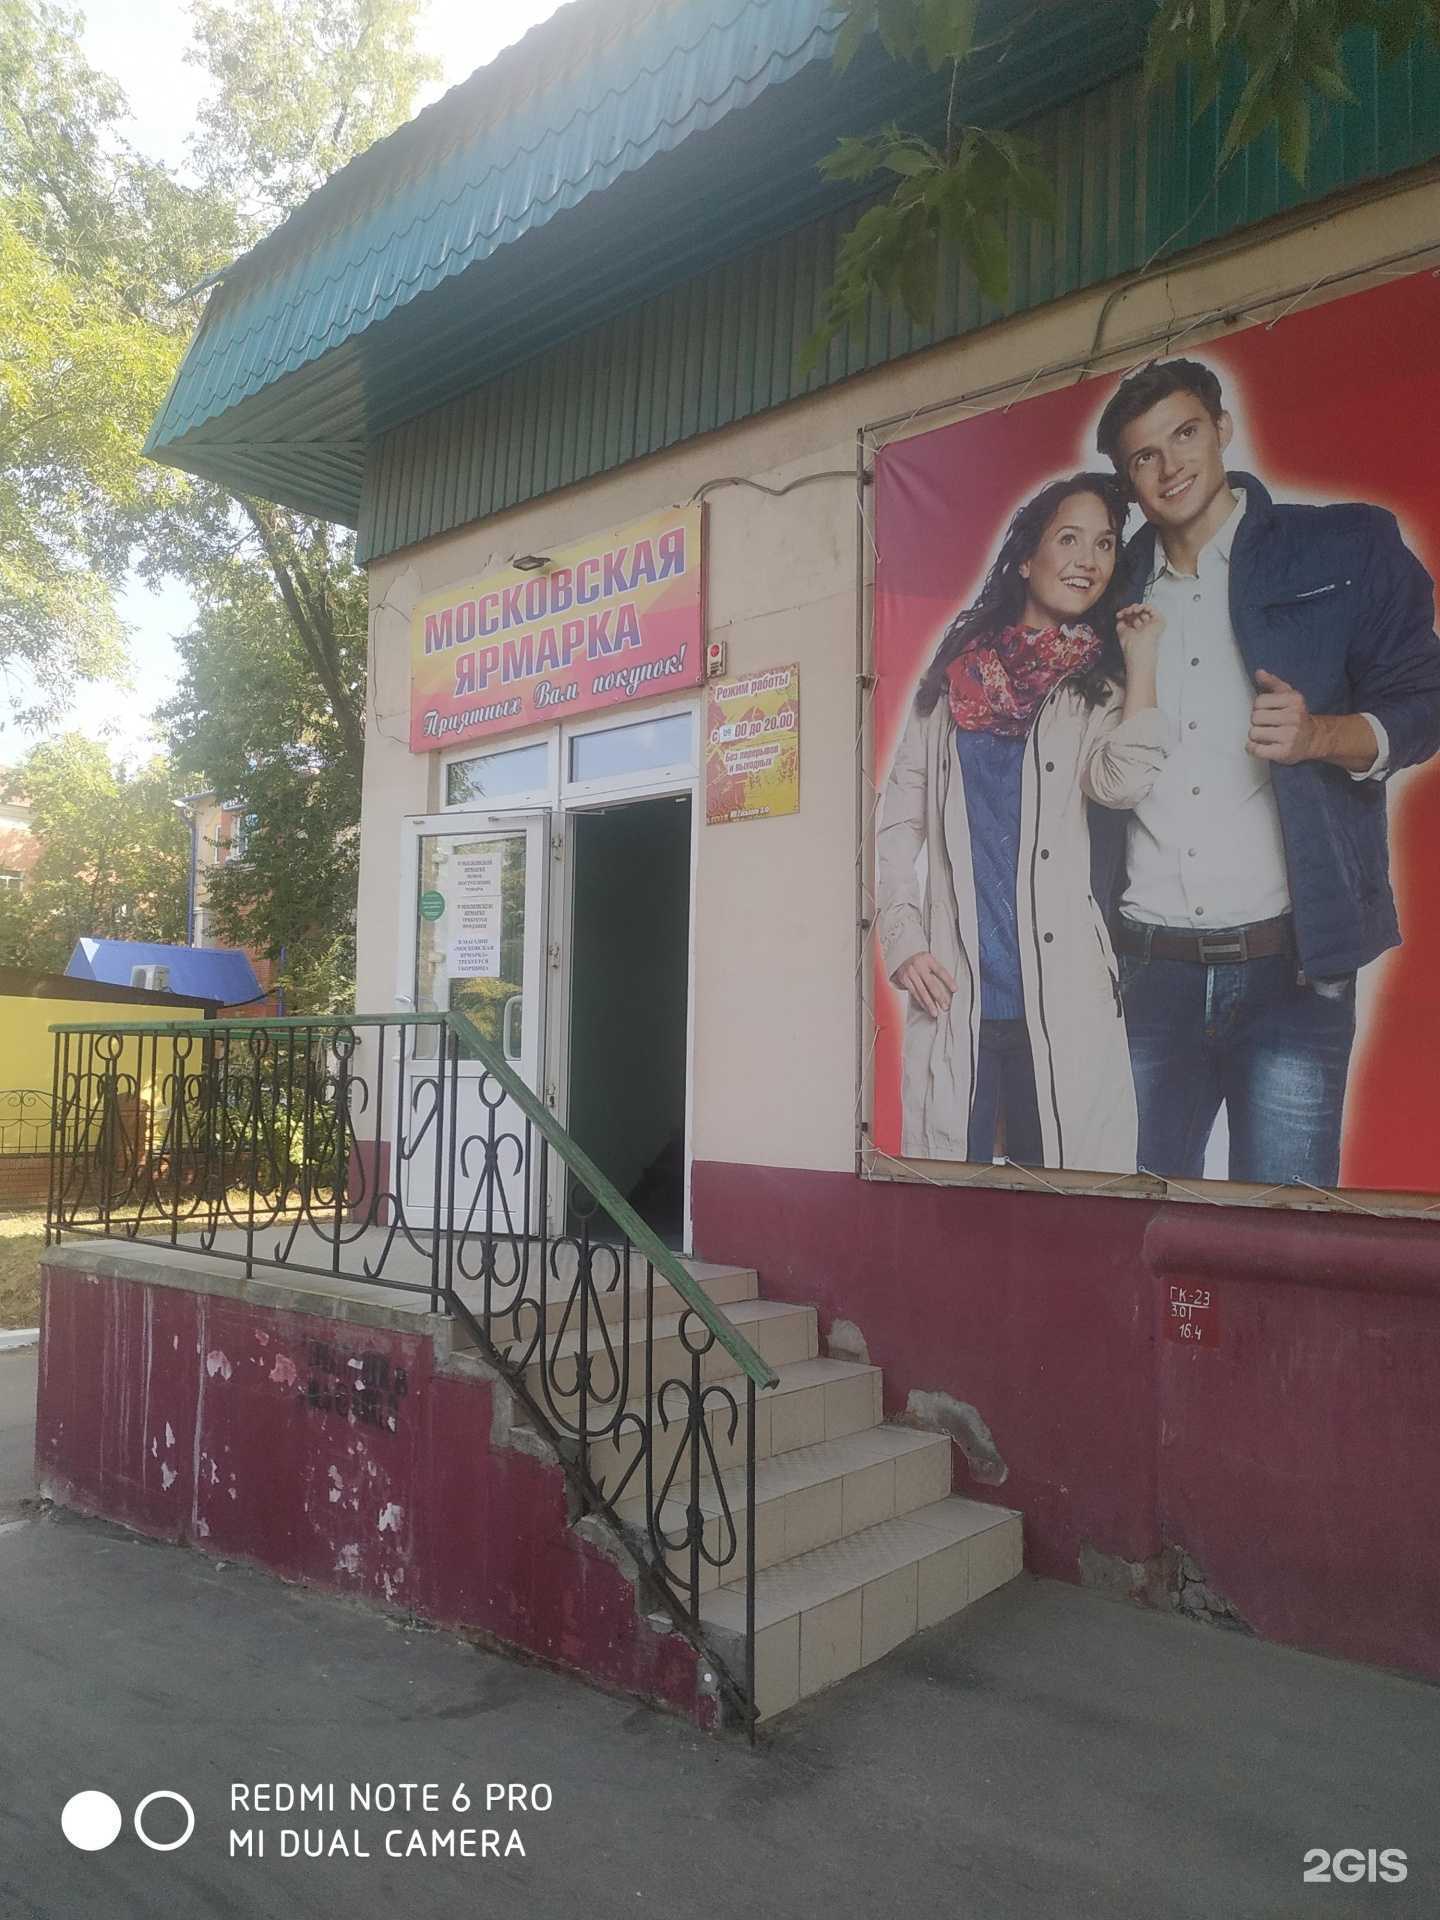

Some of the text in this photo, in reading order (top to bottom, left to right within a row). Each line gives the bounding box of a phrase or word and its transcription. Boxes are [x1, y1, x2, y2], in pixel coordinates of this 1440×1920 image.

[424, 527, 686, 656] МОСКОВСКАЯ
[423, 643, 688, 737] Приятных Вам покупок!
[454, 603, 641, 697] ЯРМАРКА
[716, 672, 789, 701] Режим работы
[749, 721, 761, 736] до
[764, 713, 793, 731] 20.00
